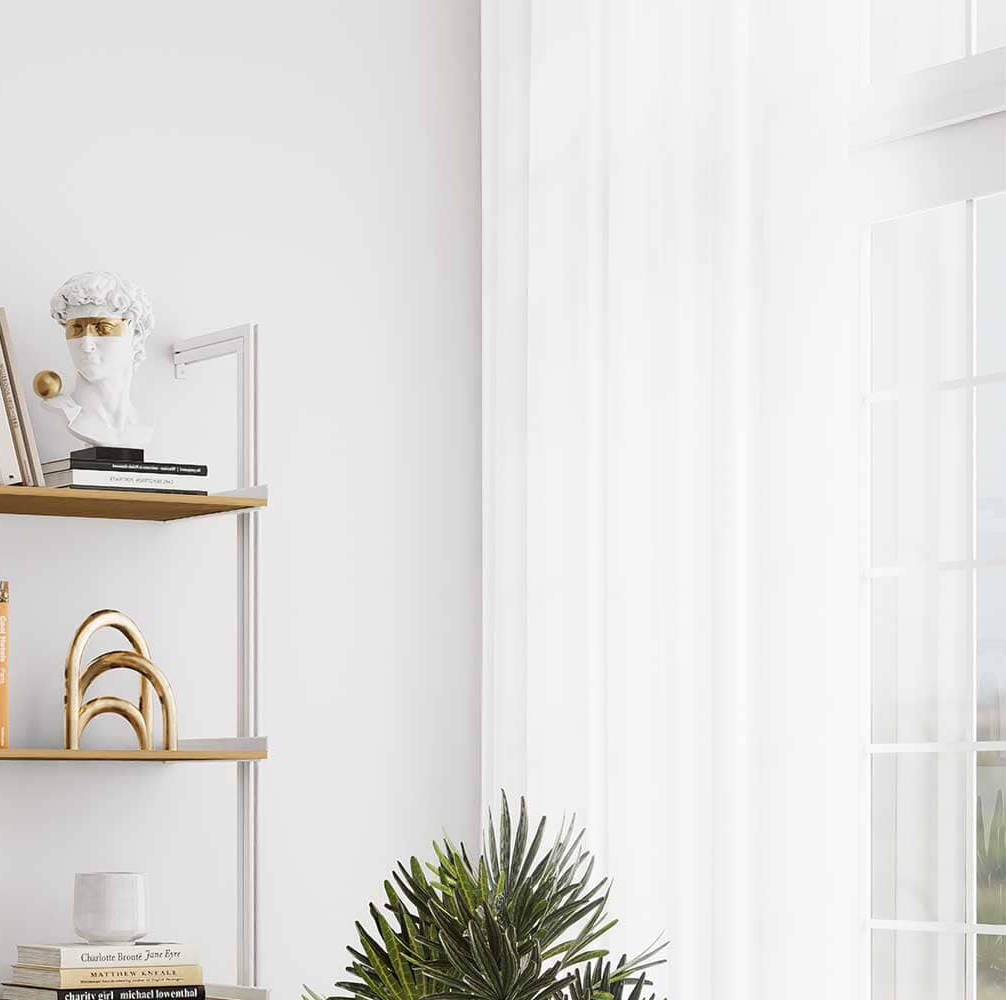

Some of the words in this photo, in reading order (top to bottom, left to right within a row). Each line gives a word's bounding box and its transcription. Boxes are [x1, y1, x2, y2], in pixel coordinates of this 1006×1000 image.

[80, 952, 116, 963] Charlotte
[117, 951, 143, 962] Brontë
[143, 949, 163, 961] Jane
[163, 947, 181, 960] Eyre
[90, 970, 137, 978] MATTHEW
[119, 989, 154, 1000] michael
[155, 987, 198, 1000] lowenthal
